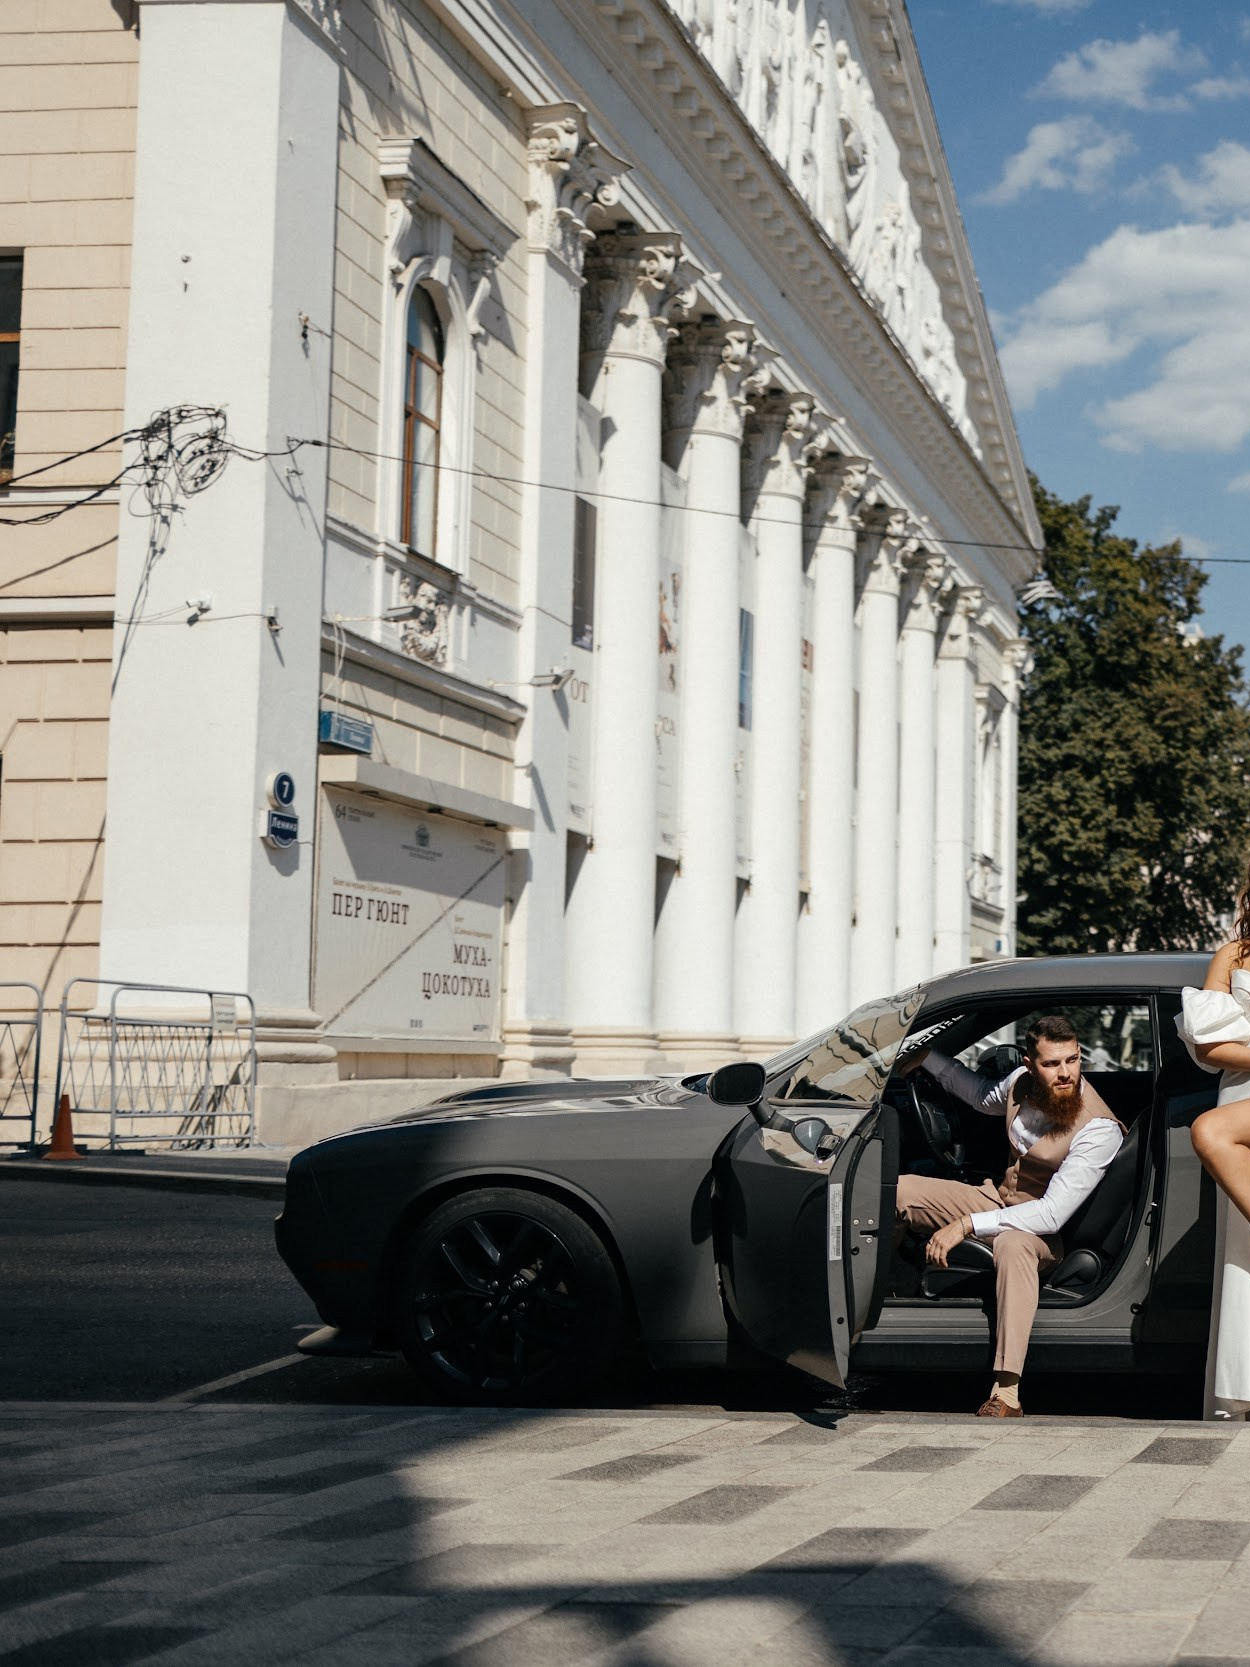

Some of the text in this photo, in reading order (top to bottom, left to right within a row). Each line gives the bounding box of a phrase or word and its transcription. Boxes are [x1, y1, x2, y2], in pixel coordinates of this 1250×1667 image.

[282, 780, 290, 799] 7
[271, 816, 297, 832] Ленина
[332, 893, 410, 925] ПЕР ГЮНТ
[453, 943, 492, 967] МУХА-
[422, 972, 491, 1000] ЦОКОТУХА
